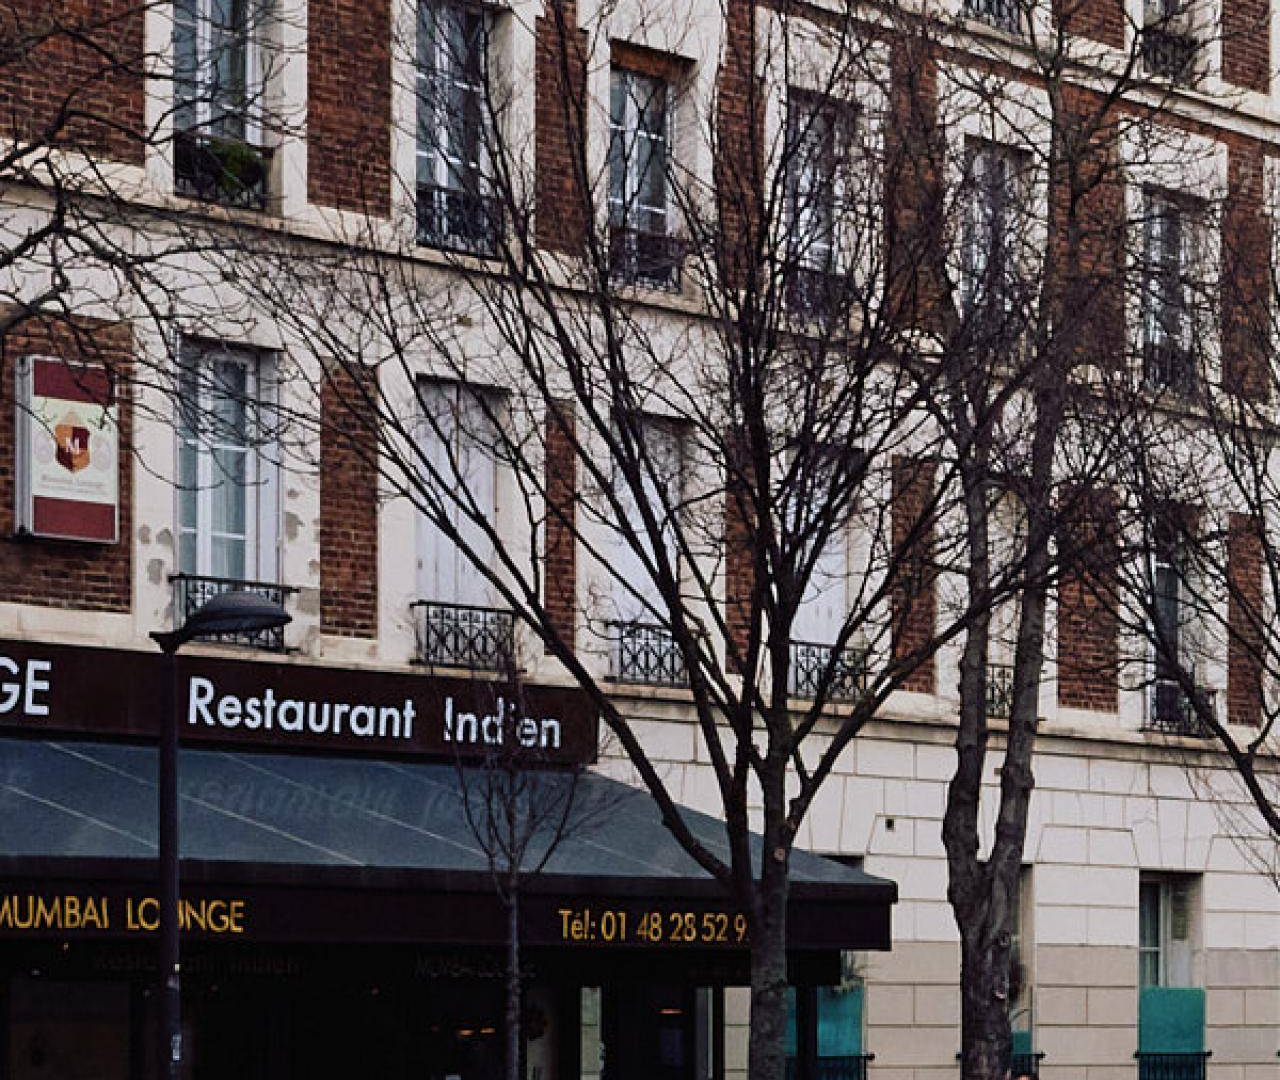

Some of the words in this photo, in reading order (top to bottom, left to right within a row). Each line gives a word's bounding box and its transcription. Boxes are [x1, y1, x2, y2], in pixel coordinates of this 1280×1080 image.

[187, 676, 416, 739] Restaurant
[443, 696, 561, 749] Inden
[600, 910, 627, 942] 01
[635, 912, 663, 942] 48
[669, 912, 697, 942] 28
[701, 913, 728, 942] 52
